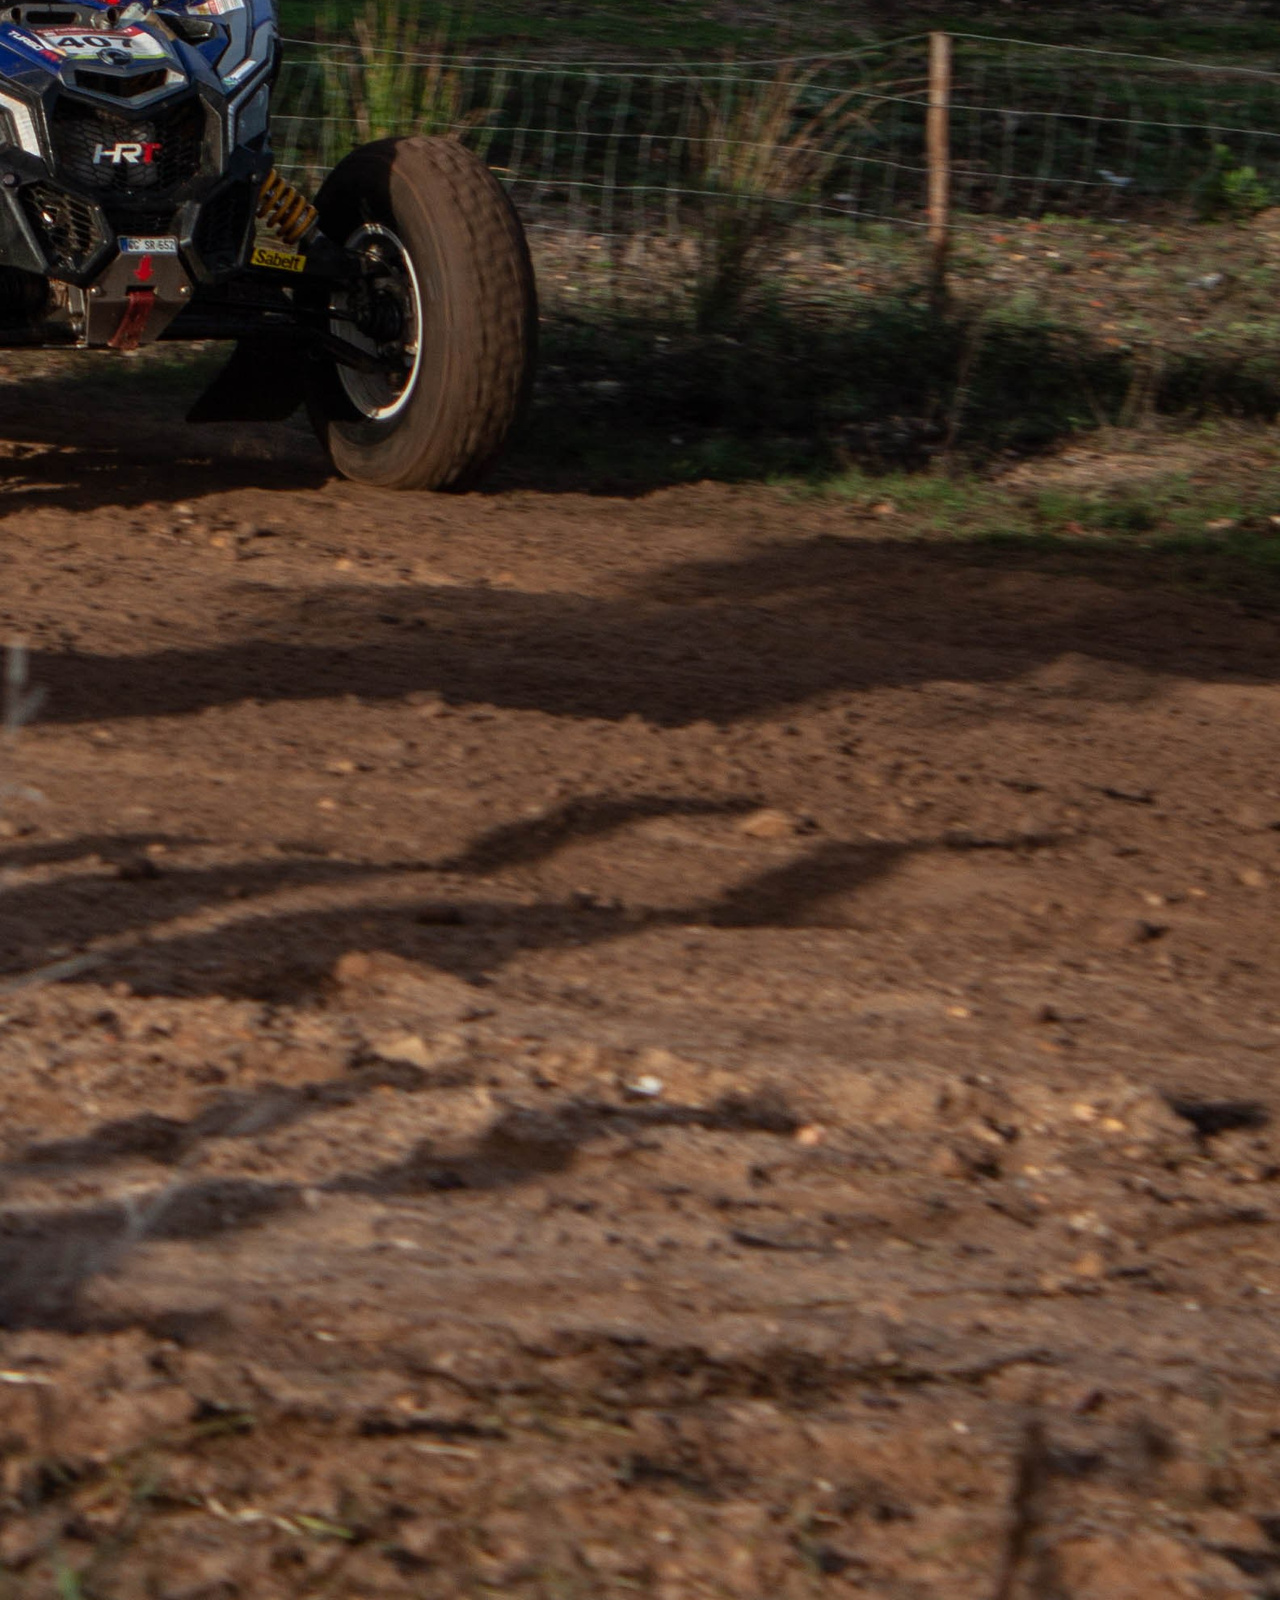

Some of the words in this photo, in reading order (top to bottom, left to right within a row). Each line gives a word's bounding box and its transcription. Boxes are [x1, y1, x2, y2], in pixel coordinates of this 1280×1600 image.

[57, 35, 134, 49] 407
[92, 143, 162, 164] HRT
[255, 249, 300, 270] Sabelt
